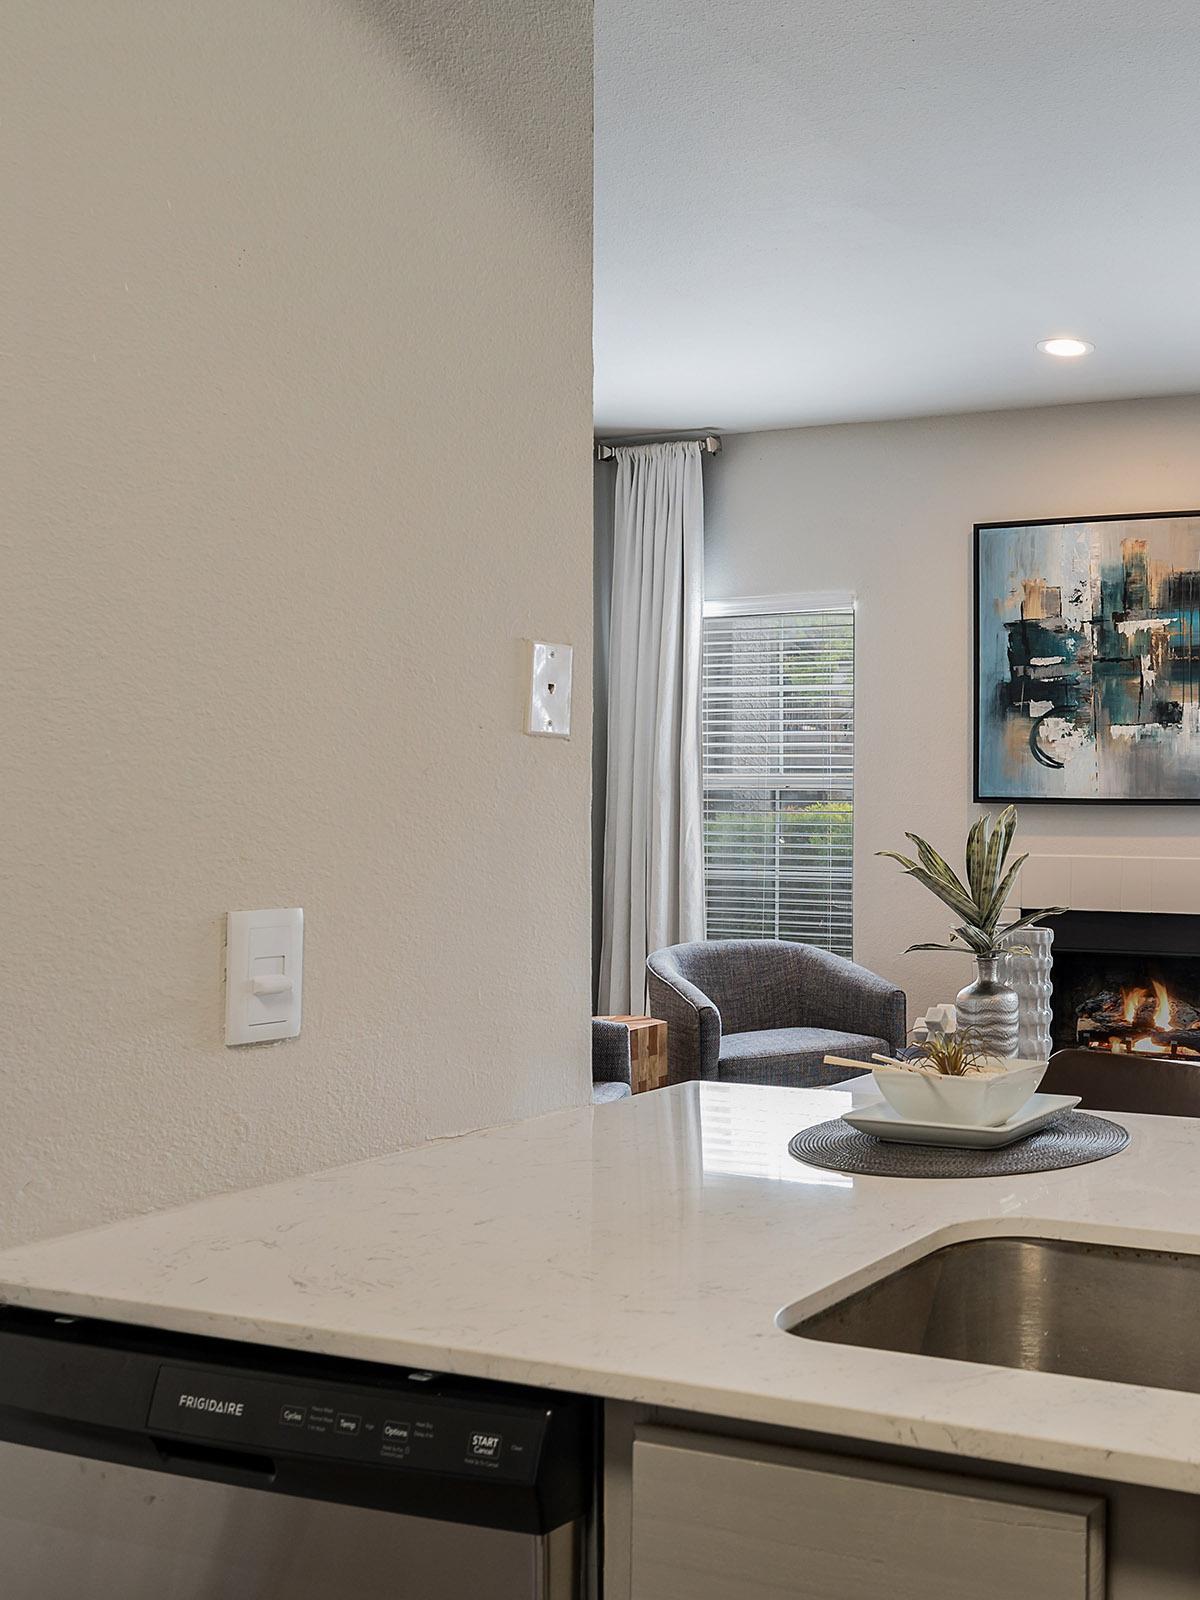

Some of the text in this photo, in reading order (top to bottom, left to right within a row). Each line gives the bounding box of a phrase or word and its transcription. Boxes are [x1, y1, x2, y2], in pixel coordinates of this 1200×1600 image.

[178, 1394, 245, 1416] FRIGIDAIRE
[283, 1410, 302, 1421] Cycles
[384, 1426, 408, 1437] Options
[472, 1435, 499, 1448] START
